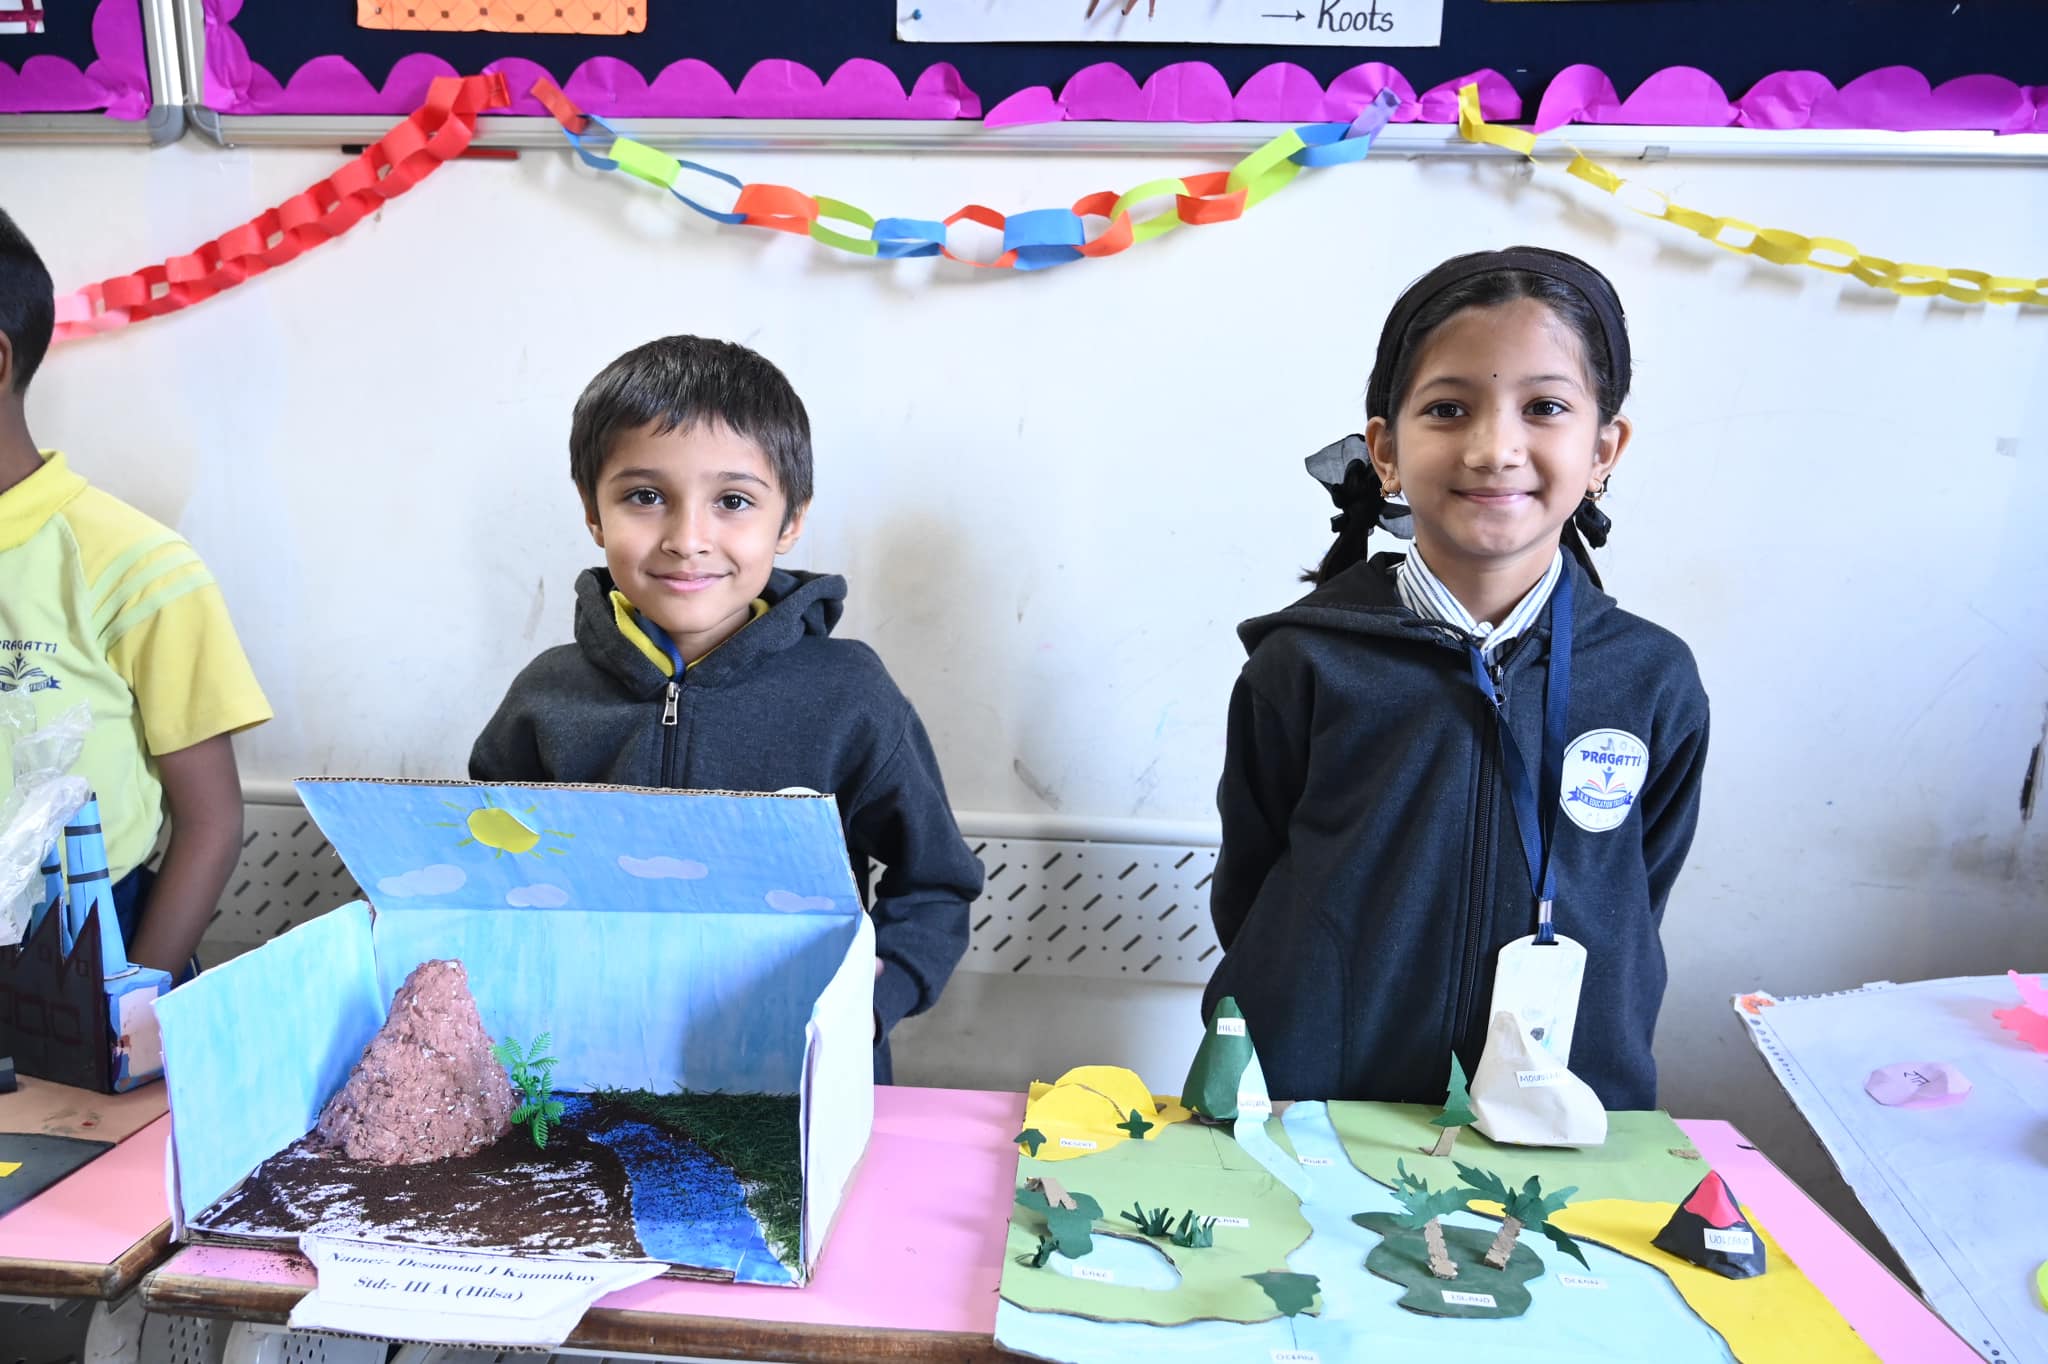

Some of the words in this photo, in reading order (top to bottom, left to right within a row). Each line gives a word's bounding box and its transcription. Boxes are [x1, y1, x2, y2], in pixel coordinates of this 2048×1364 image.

[1317, 0, 1393, 32] Roots
[0, 639, 57, 654] RAGATTI
[1580, 750, 1642, 767] PRAGATTI
[396, 1257, 483, 1273] Desmond
[403, 1280, 431, 1293] III
[433, 1283, 450, 1295] A
